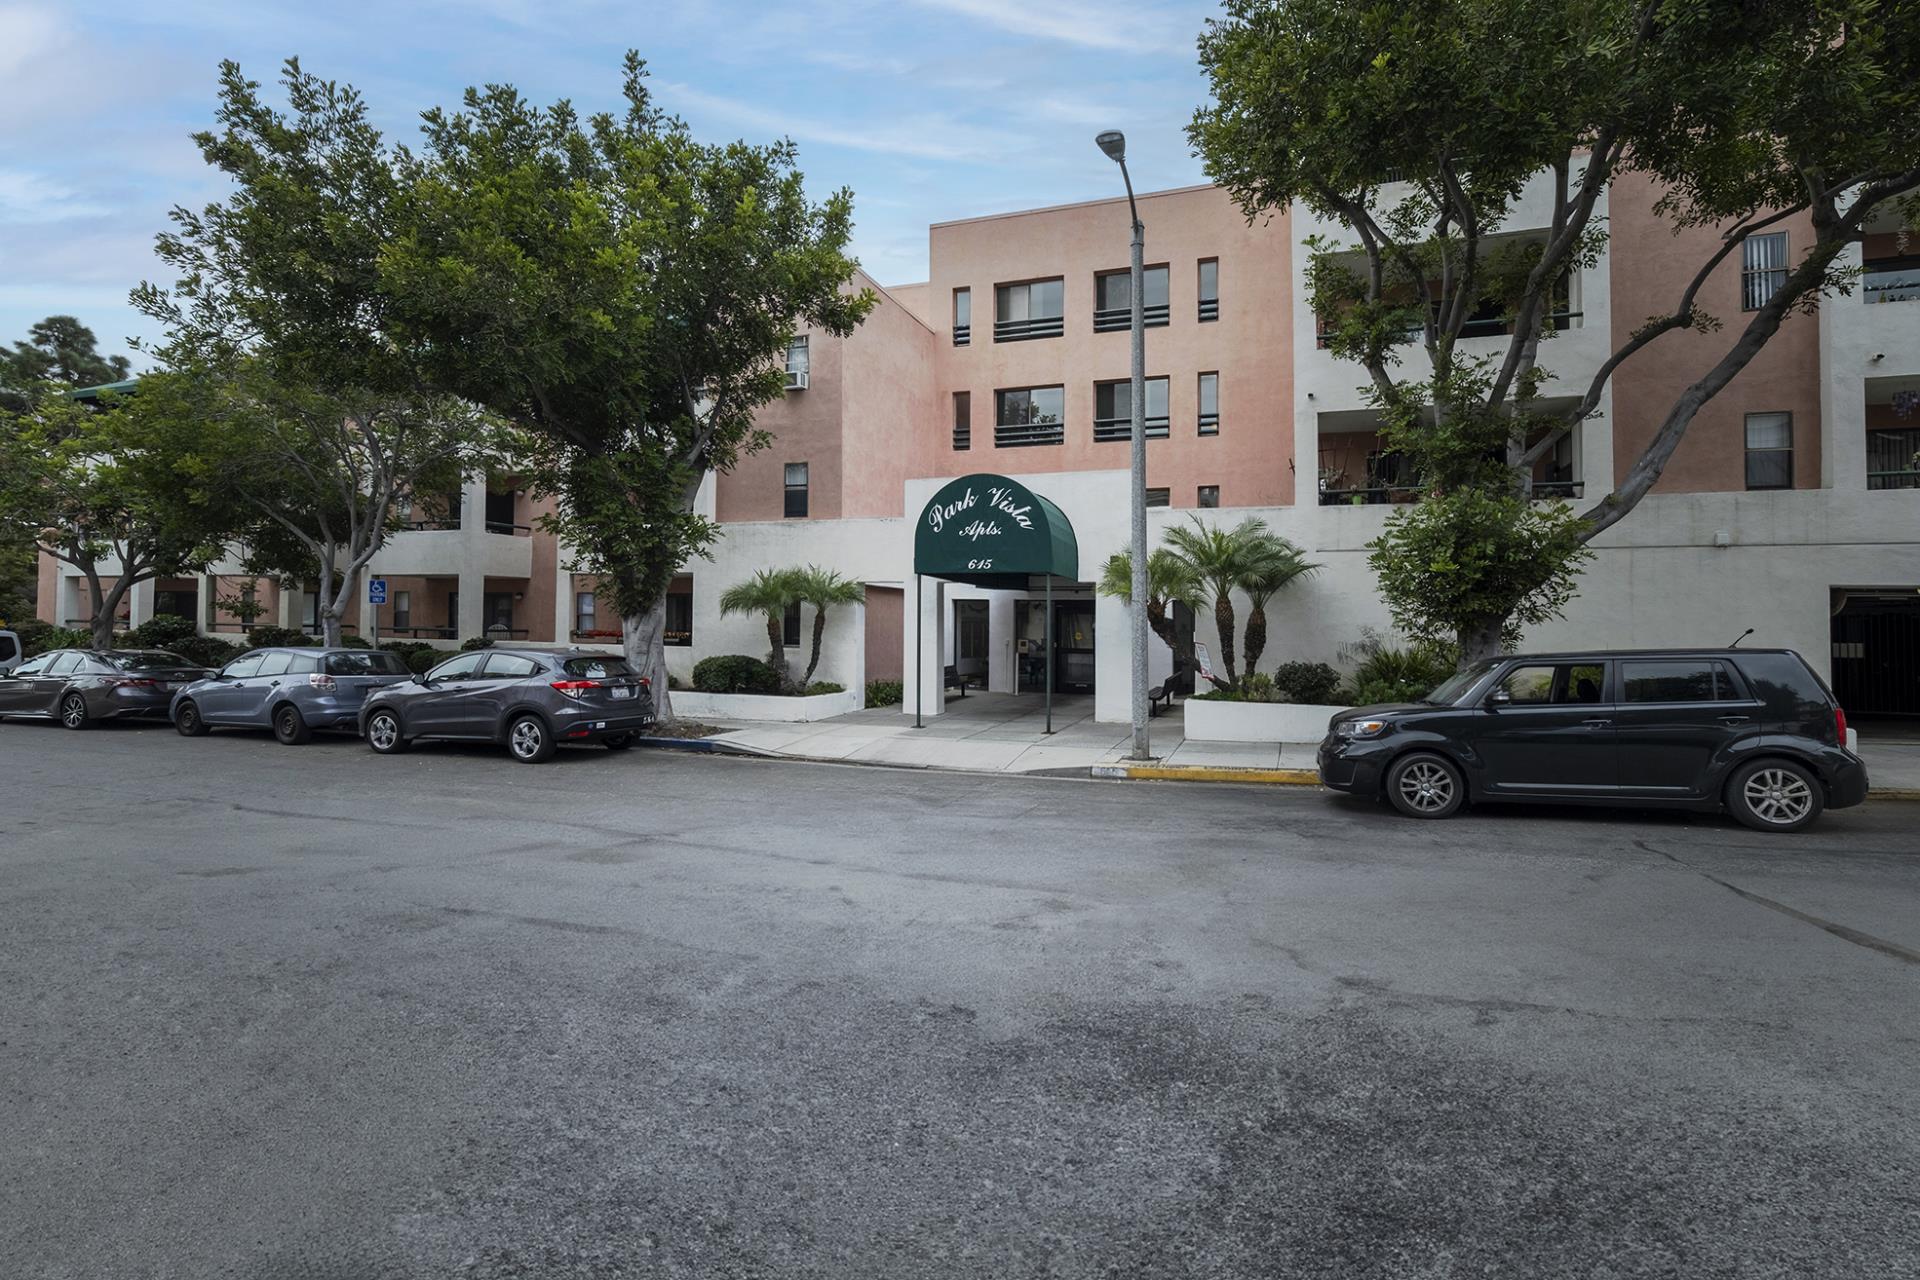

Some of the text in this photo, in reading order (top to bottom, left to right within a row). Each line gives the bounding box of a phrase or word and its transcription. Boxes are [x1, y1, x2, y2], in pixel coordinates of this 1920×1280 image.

[928, 487, 1035, 533] Park Vista
[958, 520, 1002, 542] Apts.
[967, 559, 993, 570] 615
